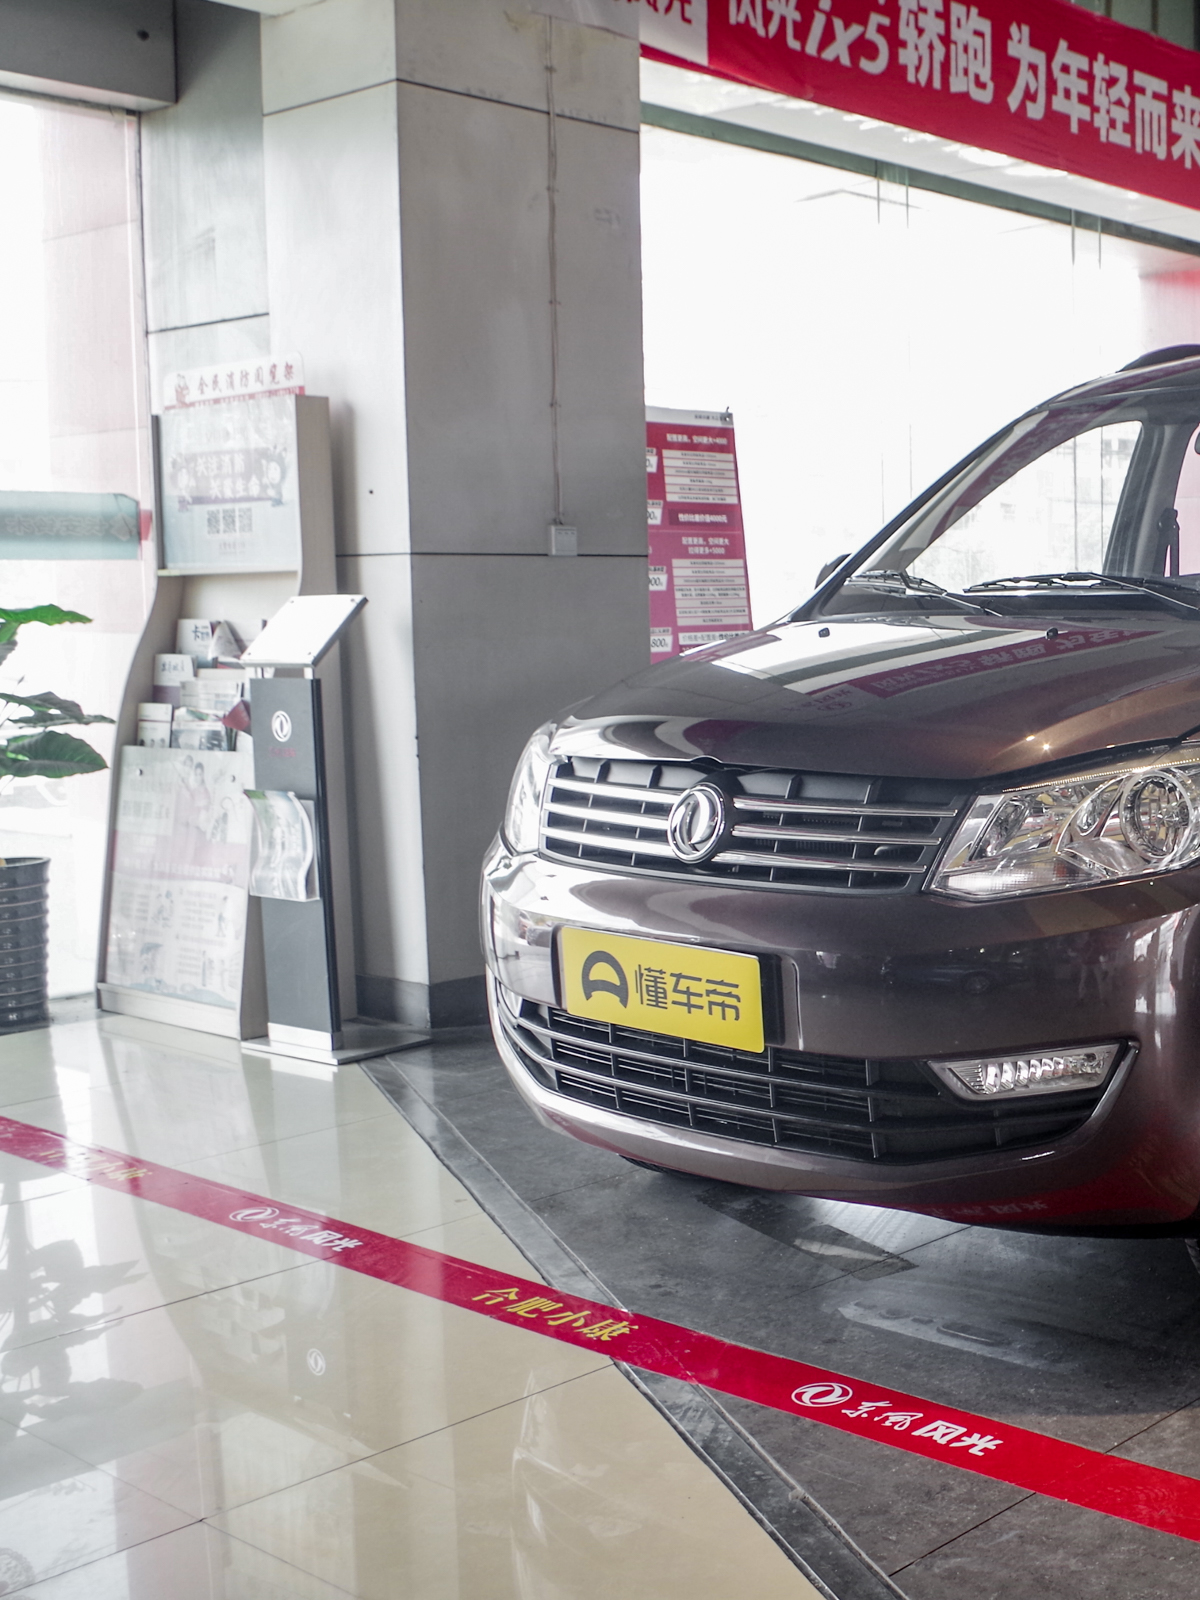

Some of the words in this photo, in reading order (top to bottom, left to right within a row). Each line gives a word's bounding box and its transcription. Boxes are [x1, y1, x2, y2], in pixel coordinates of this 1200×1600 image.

[635, 964, 742, 1022] 懂车帝
[471, 1287, 639, 1341] 合肥小康
